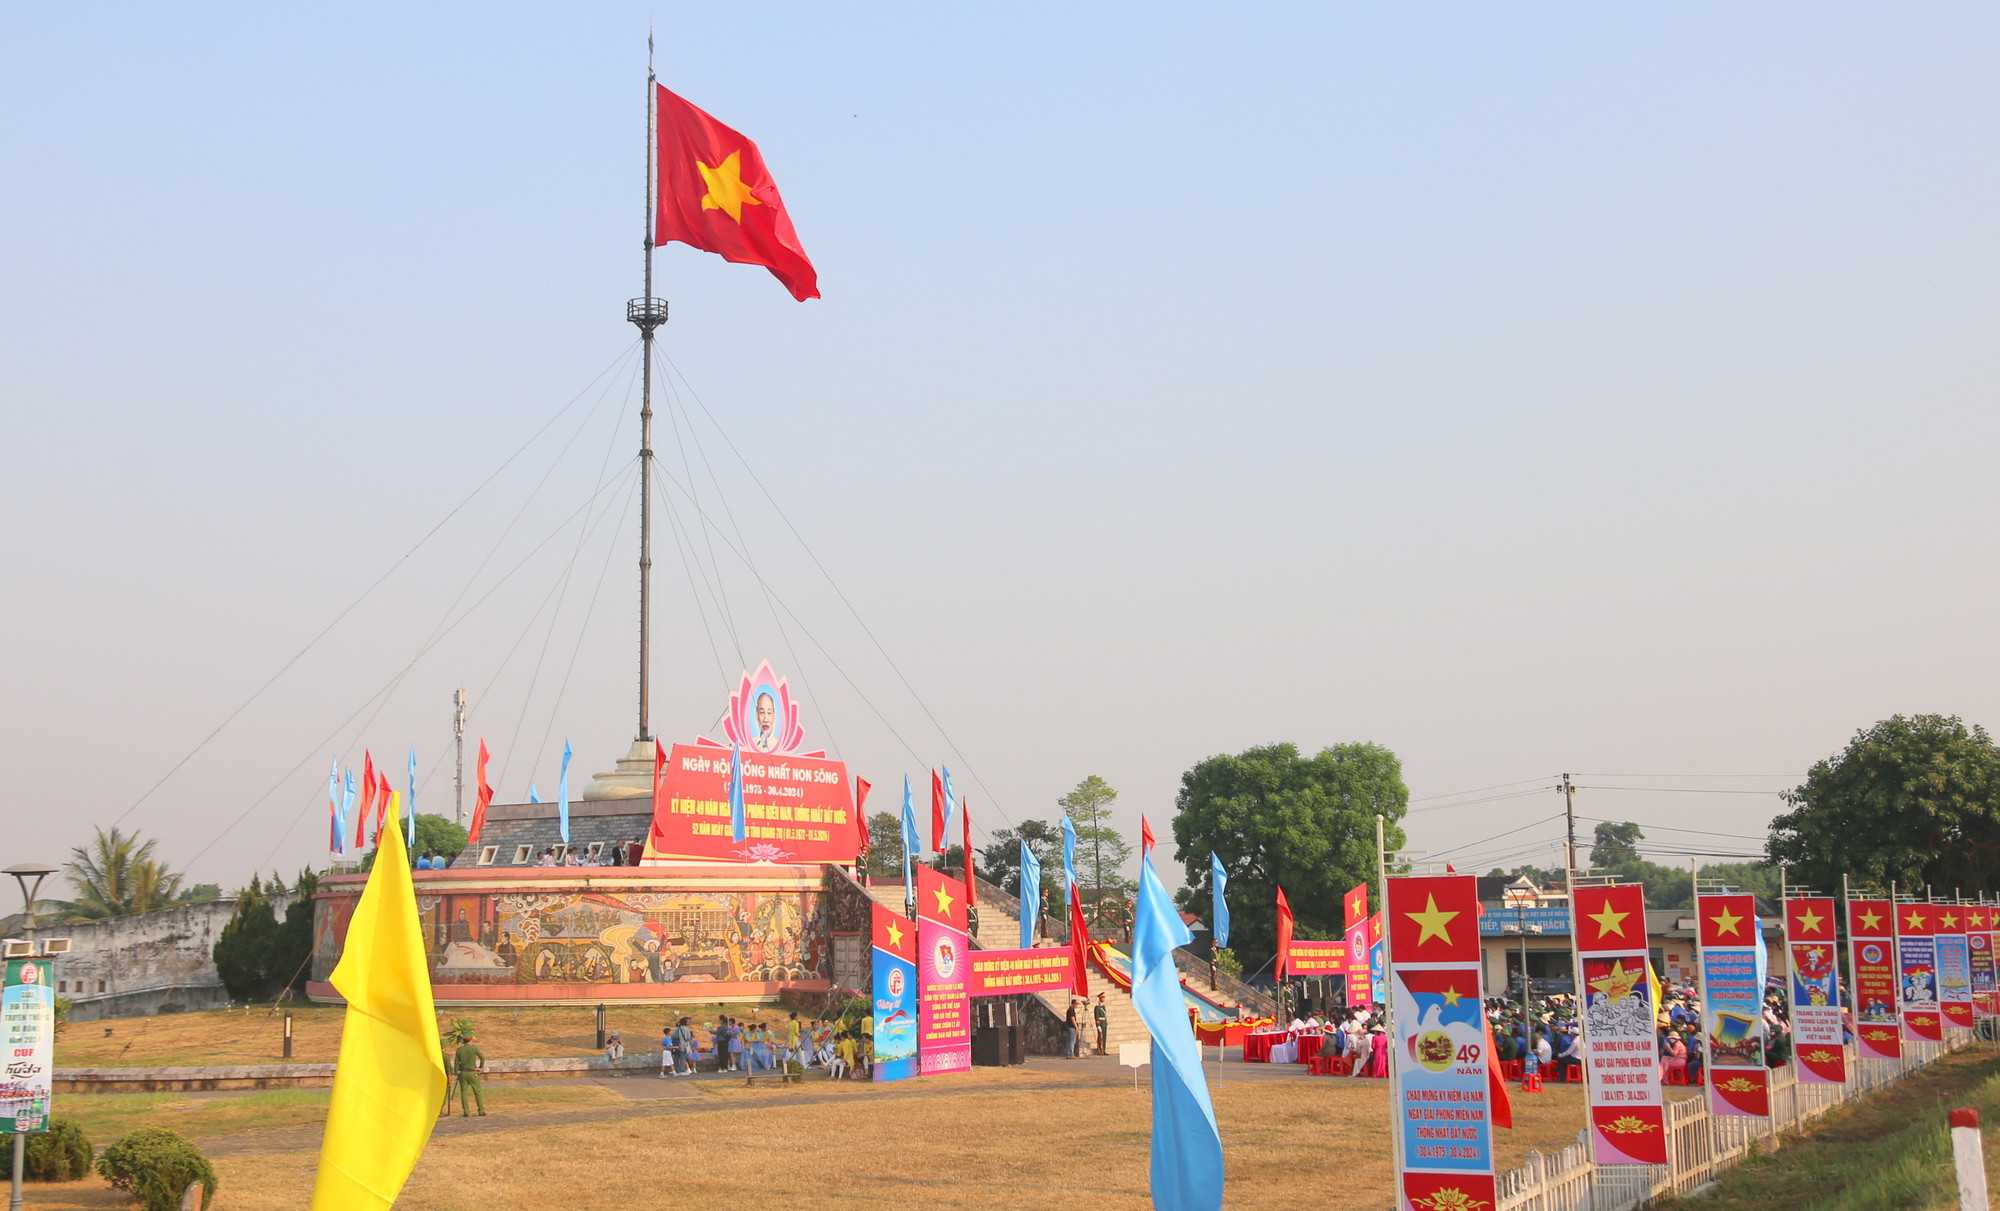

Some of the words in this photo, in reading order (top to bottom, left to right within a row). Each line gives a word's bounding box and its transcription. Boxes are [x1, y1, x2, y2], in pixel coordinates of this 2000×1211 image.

[682, 755, 711, 773] NGÀY
[712, 758, 731, 778] HỘI
[740, 758, 766, 778] ỐNG
[768, 762, 790, 780] NHẤT
[792, 768, 812, 782] NON
[814, 768, 839, 784] SÔNG
[1456, 1044, 1480, 1064] 49
[1456, 1067, 1482, 1075] NĂM
